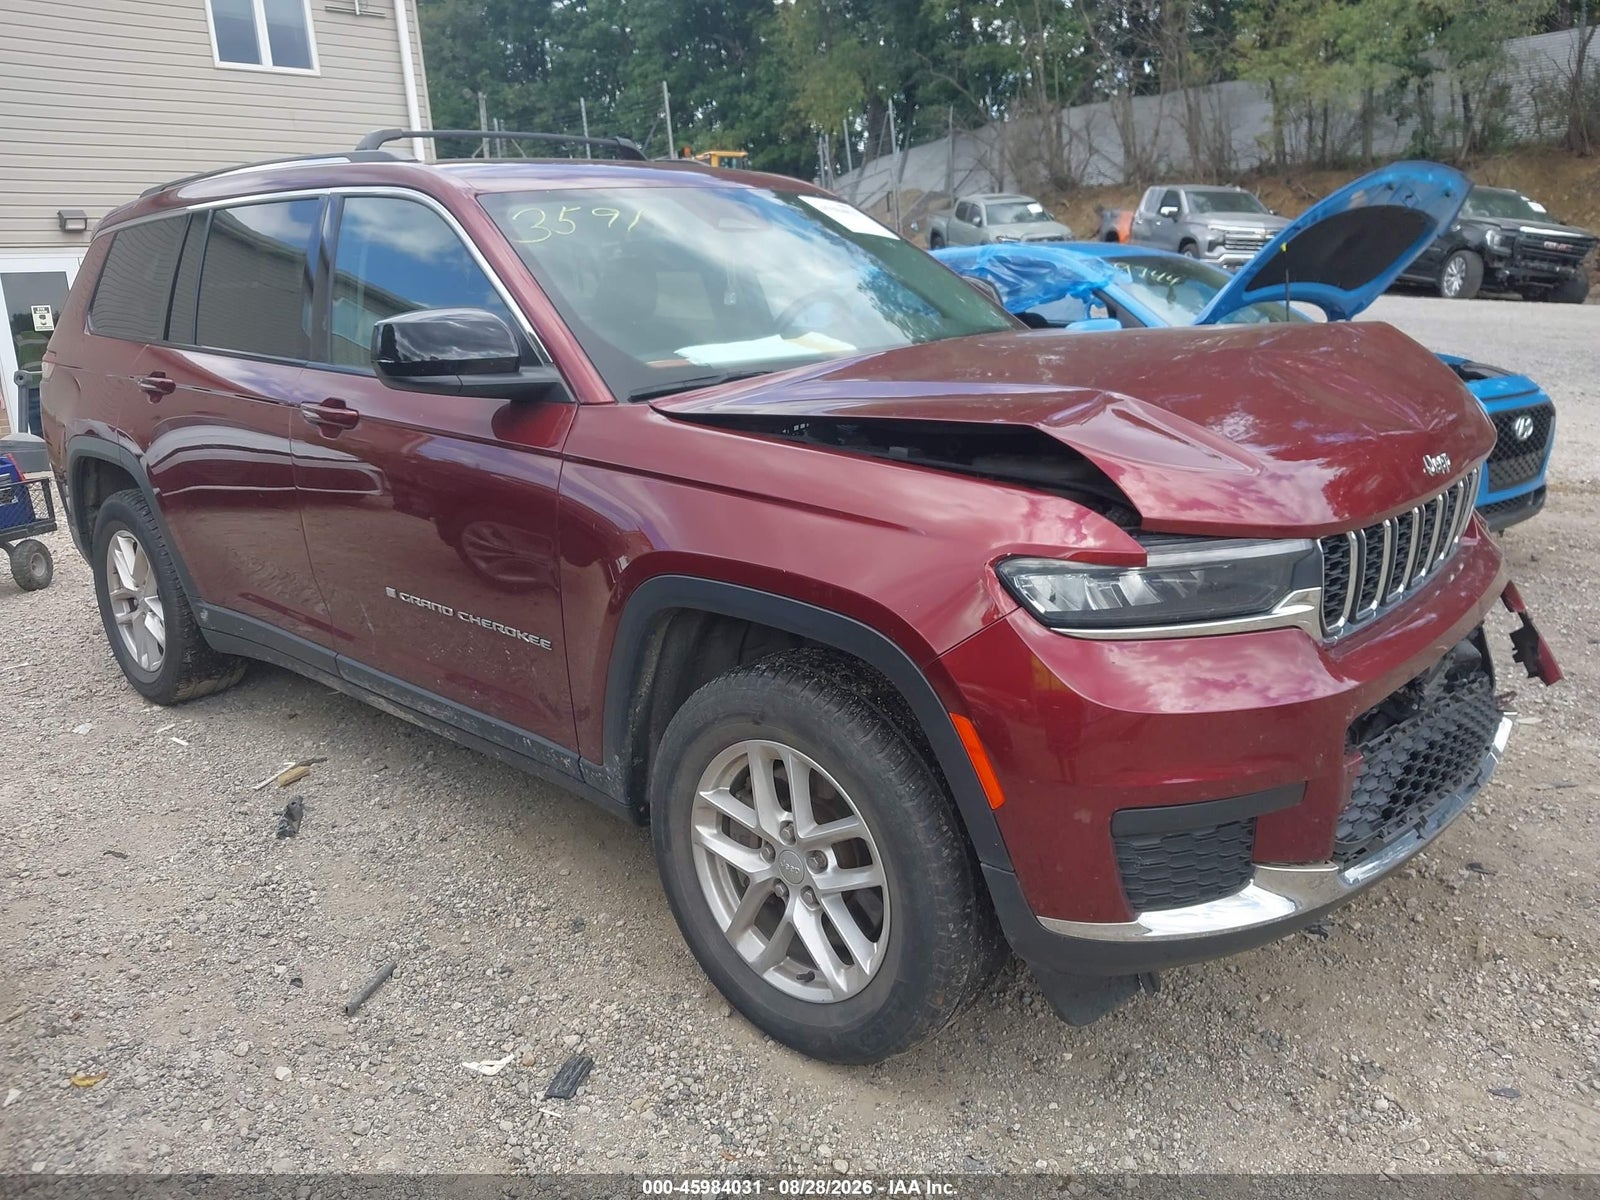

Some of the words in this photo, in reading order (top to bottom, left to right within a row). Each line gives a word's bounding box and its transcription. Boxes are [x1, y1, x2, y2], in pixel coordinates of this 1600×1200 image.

[512, 206, 648, 243] 3591
[1422, 453, 1451, 476] Jeep
[400, 592, 453, 616] GRAND
[457, 611, 553, 650] CHEROKEE
